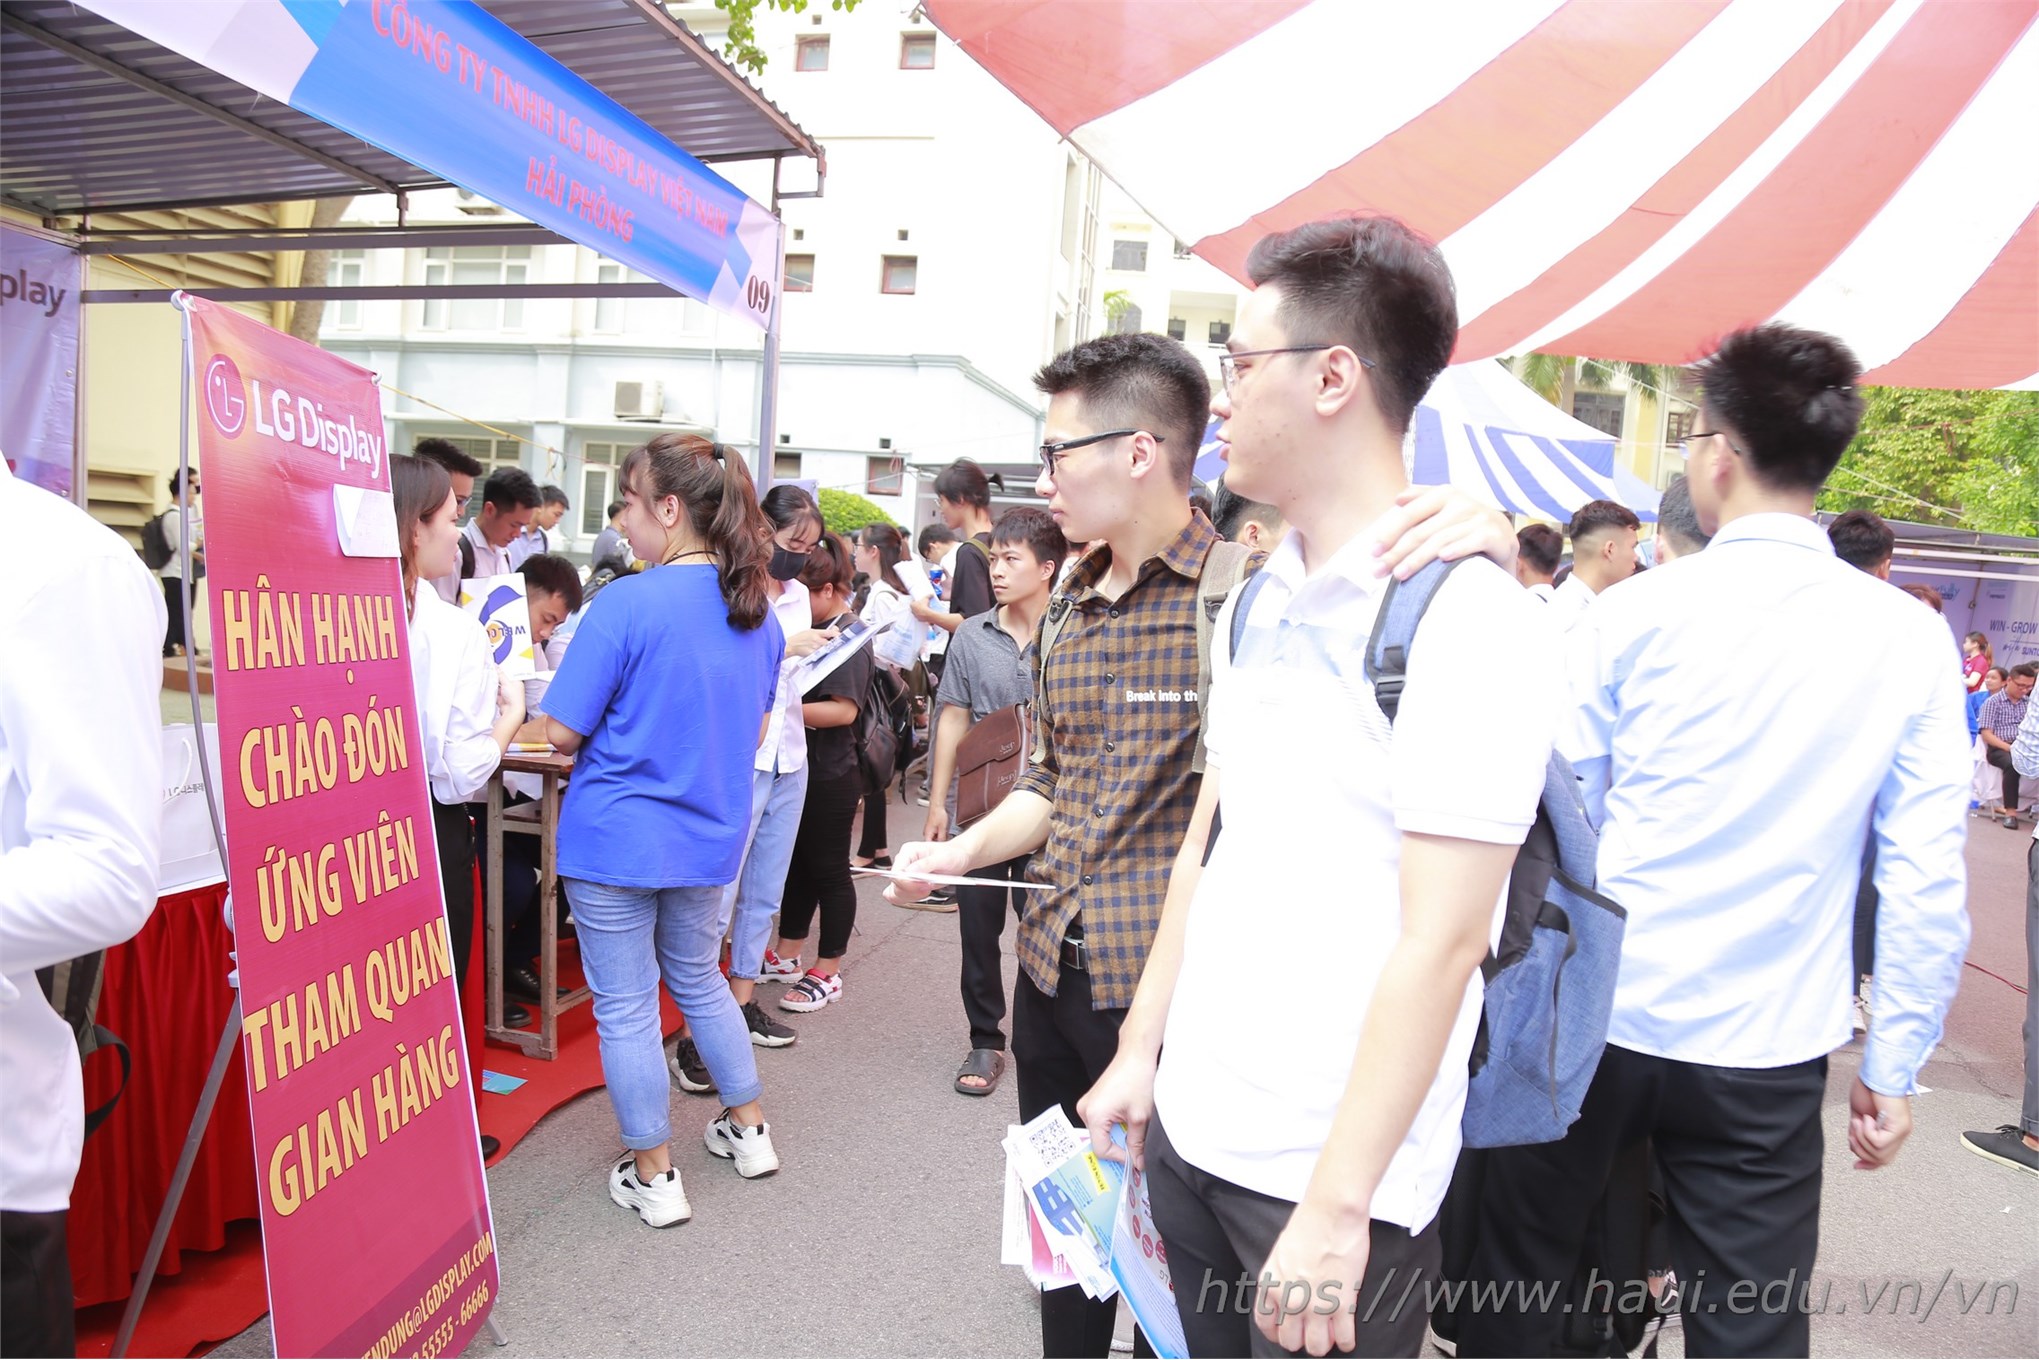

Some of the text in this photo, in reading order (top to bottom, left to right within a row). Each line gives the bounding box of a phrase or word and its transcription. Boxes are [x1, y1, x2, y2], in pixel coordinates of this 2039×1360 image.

[372, 0, 729, 239] CÔNG TY TNHH LG DISPLAY VIỆT NAM
[526, 155, 635, 243] HẢI PHÒNG
[747, 275, 770, 313] 09
[252, 379, 296, 442] LG
[298, 396, 382, 479] Display
[222, 574, 399, 684] HÂN HẠNH
[1990, 620, 2006, 632] WIN
[2011, 621, 2038, 634] GROW
[1126, 691, 1156, 702] Break
[1158, 690, 1181, 702] into
[240, 694, 410, 808] CHÀO ĐÓN
[256, 809, 421, 944] ỨNG VIÊN
[243, 916, 453, 1094] THAM QUAN
[268, 1024, 461, 1217] GIAN HÀNG
[460, 1279, 489, 1326] 66666
